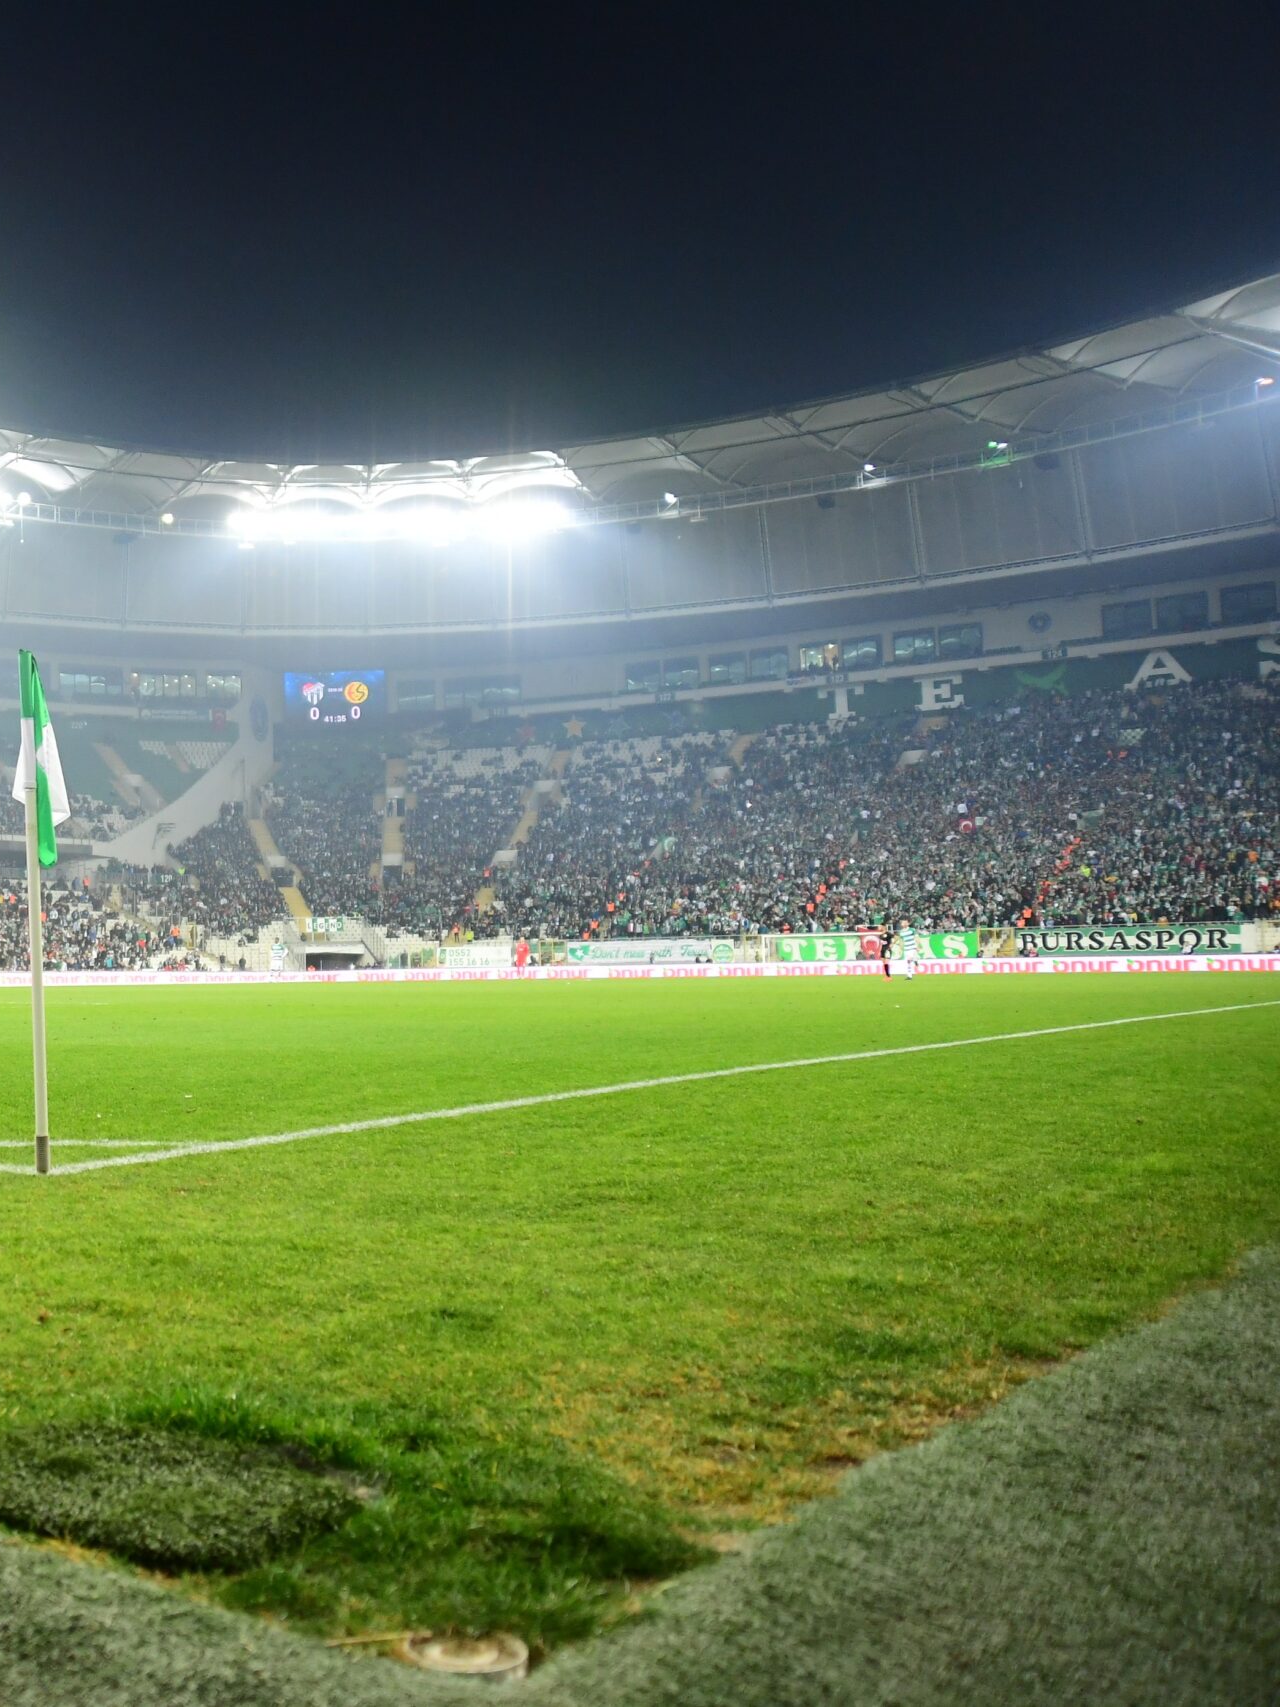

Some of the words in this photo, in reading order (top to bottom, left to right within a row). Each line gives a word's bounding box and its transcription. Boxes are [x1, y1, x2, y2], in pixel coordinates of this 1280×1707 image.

[310, 707, 319, 720] 0
[351, 706, 360, 719] 0
[1020, 929, 1229, 952] BURSASPOR
[914, 962, 972, 974] onur
[982, 961, 1044, 974] onur
[1053, 960, 1118, 973] onur
[1127, 959, 1197, 972] onur
[1206, 958, 1280, 972] onur
